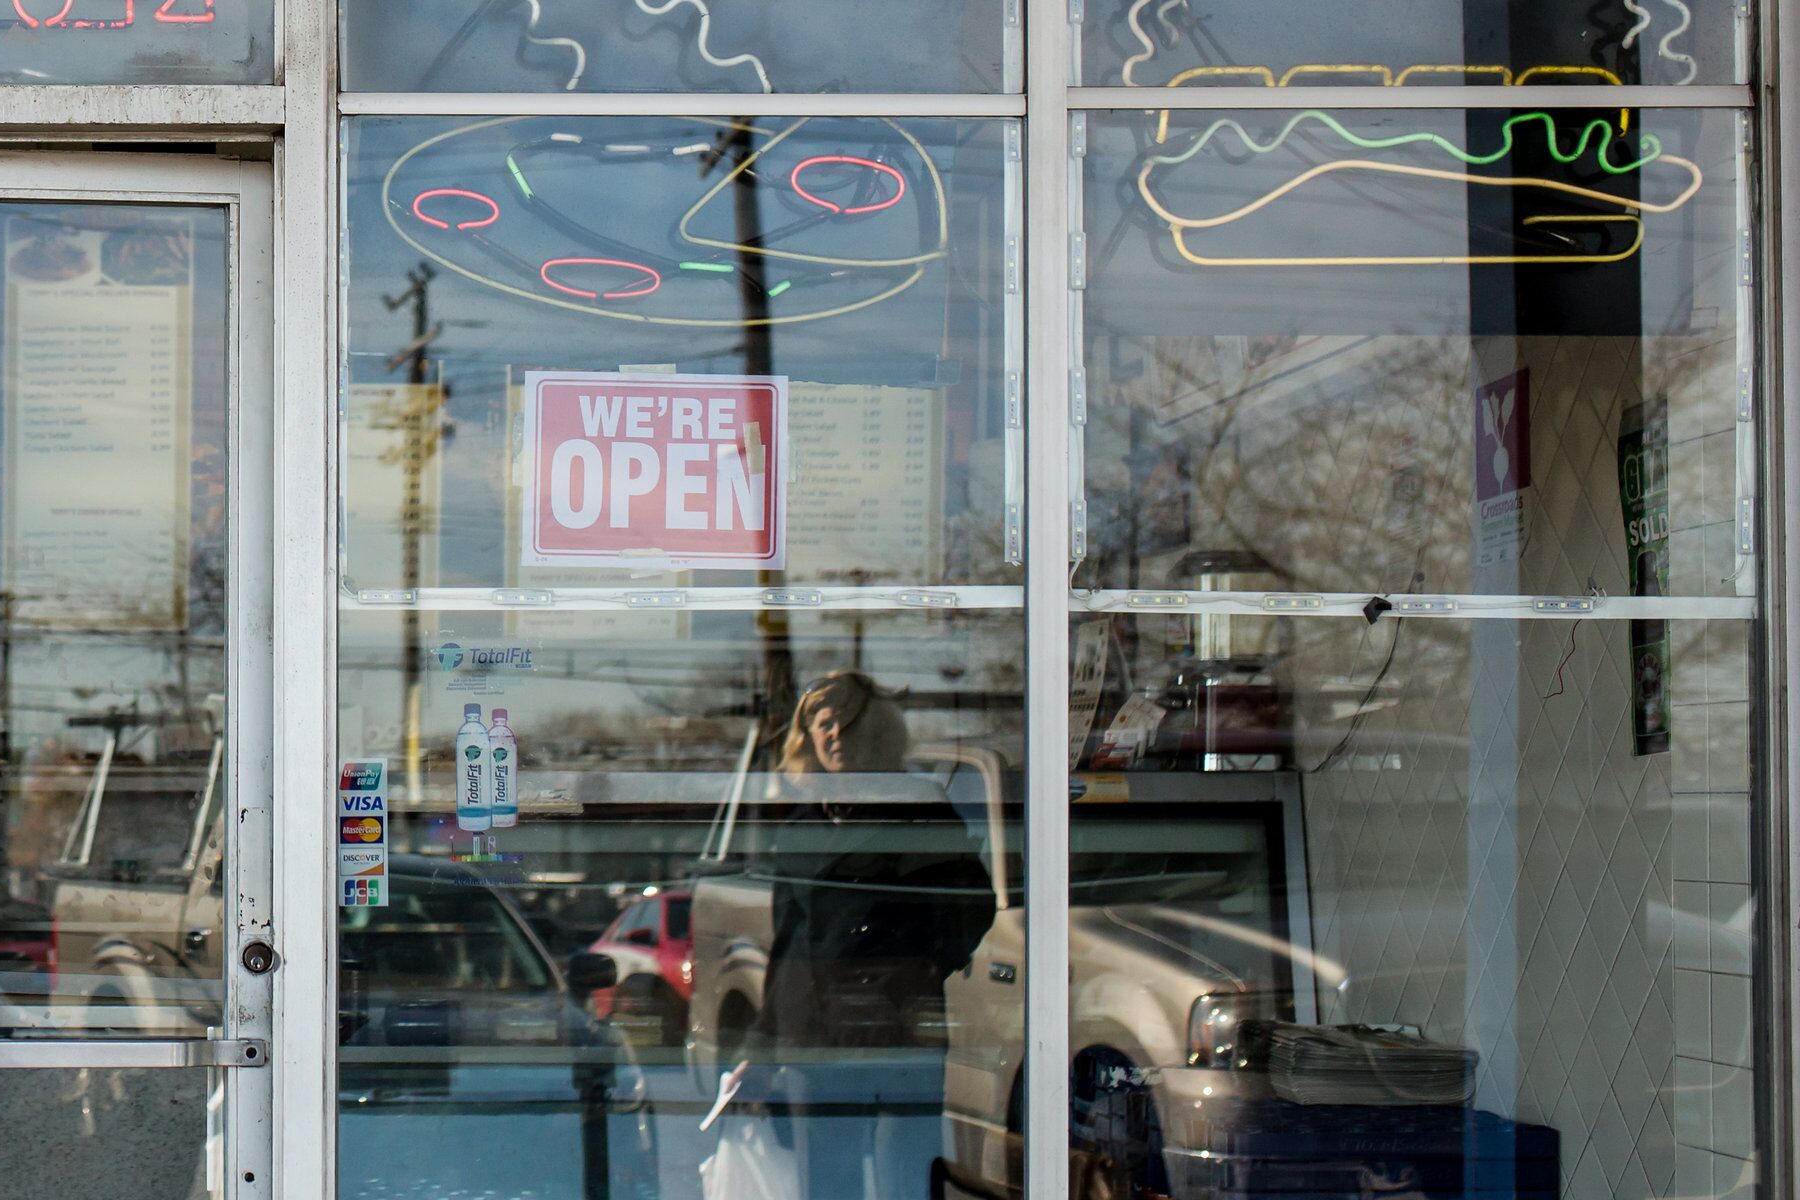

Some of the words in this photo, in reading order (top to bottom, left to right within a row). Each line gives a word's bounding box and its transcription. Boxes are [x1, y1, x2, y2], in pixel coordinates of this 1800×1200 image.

[579, 395, 737, 440] WE'RE
[550, 441, 767, 531] OPEN
[1629, 512, 1668, 546] SOLD
[470, 646, 532, 664] TotalFit
[467, 764, 479, 805] TotalFit
[495, 765, 506, 803] TotalFit
[343, 796, 383, 811] VISA
[343, 854, 380, 862] DISCOVER
[344, 885, 379, 899] JCB
